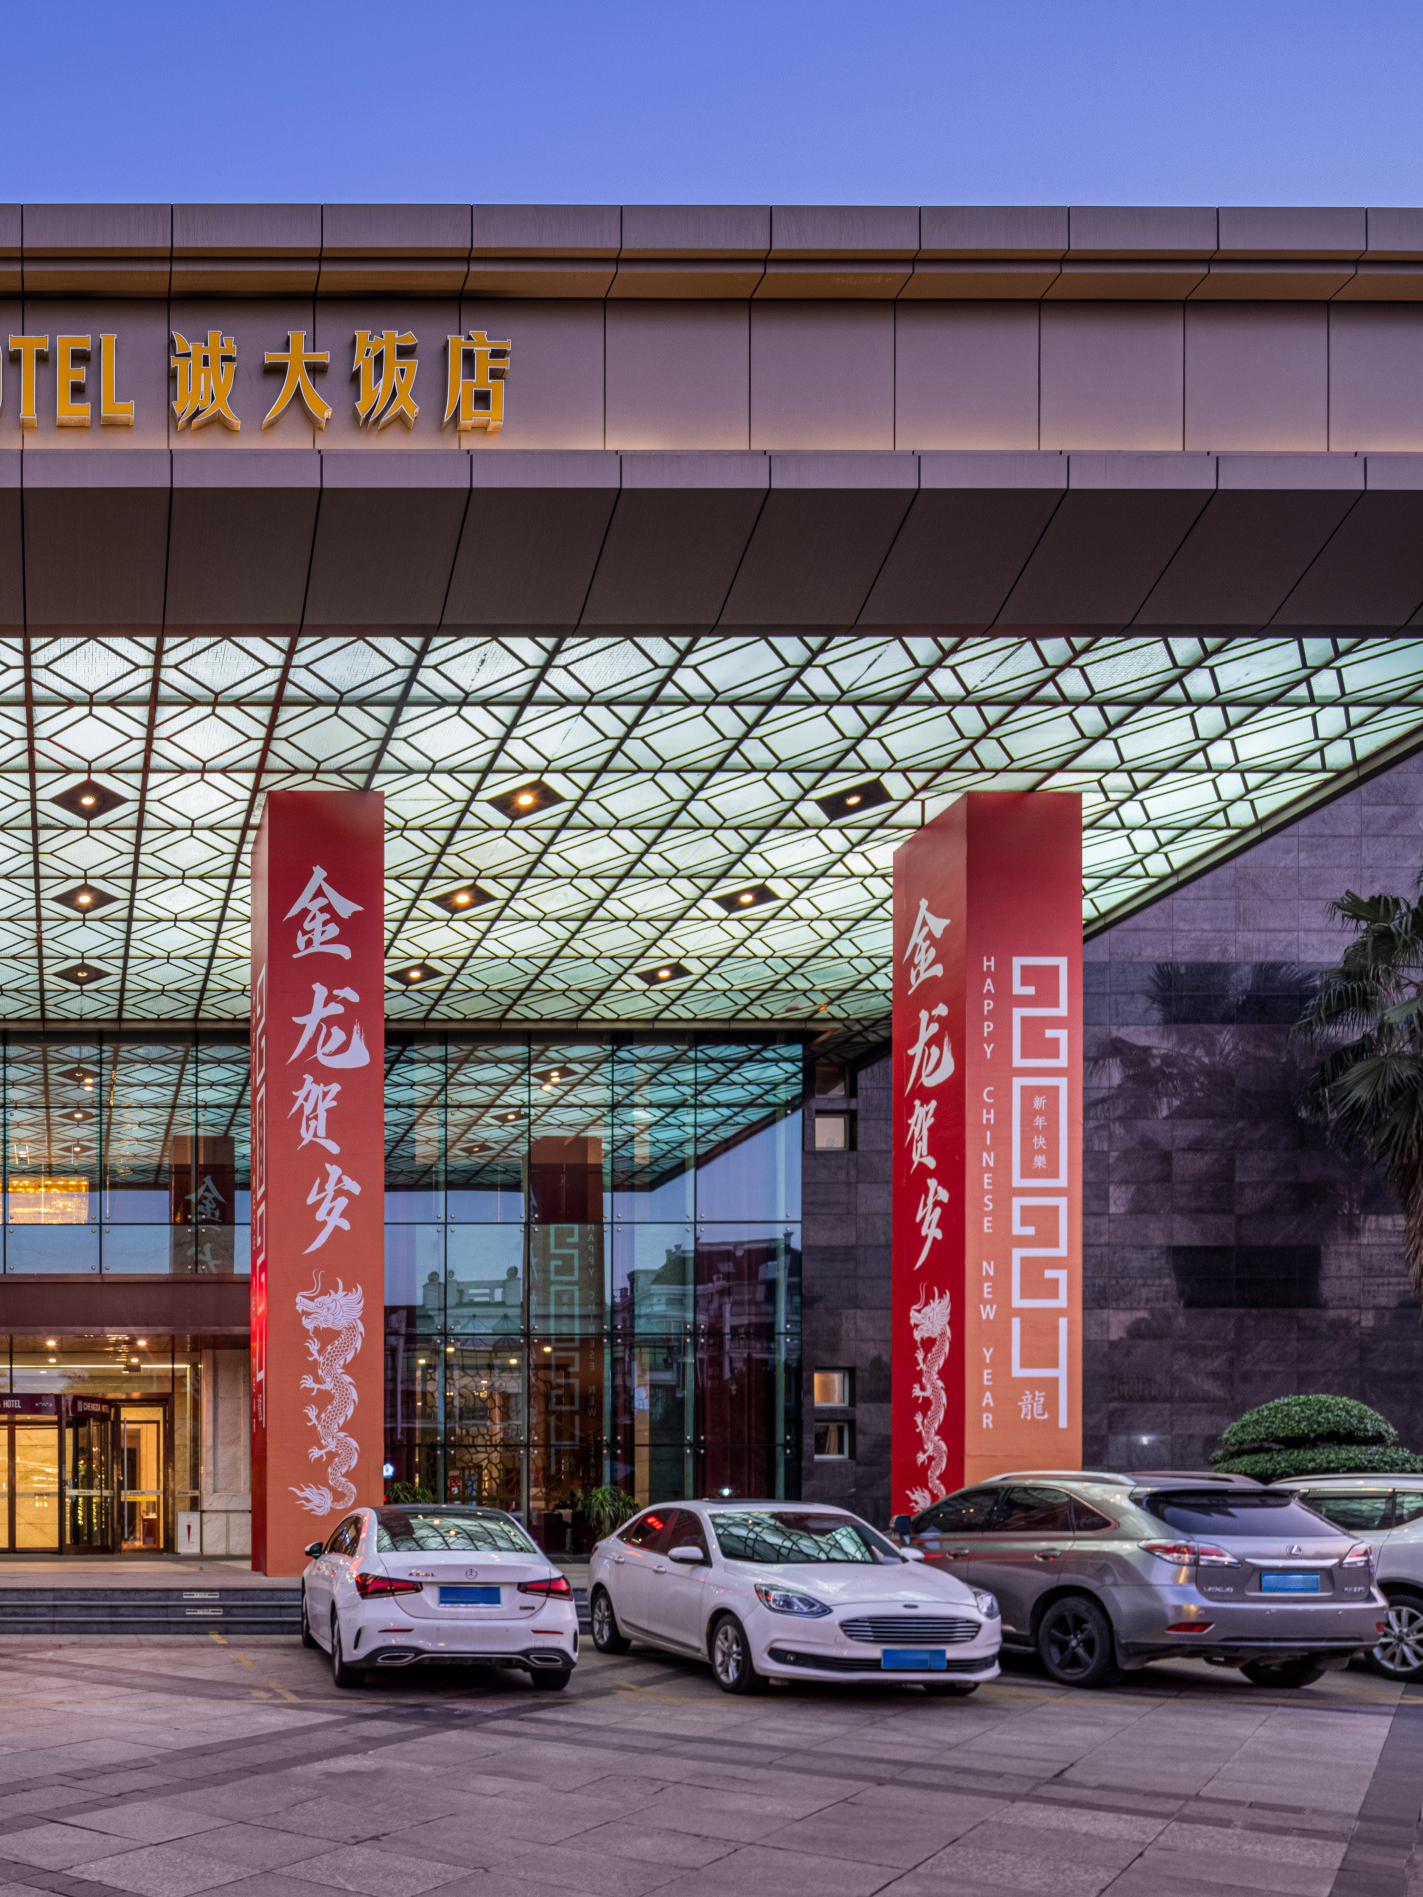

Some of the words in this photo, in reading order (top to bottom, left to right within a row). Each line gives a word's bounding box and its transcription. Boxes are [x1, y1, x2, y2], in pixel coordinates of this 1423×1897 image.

[170, 329, 512, 432] 诚大饭店
[982, 956, 996, 1060] HAPPY
[282, 865, 372, 1255] 金龙贺岁
[902, 897, 956, 1271] 金龙贺岁
[982, 1086, 995, 1234] CHINESE
[1032, 1094, 1048, 1171] 新年快樂
[979, 1260, 998, 1321] NEW
[3, 1399, 22, 1409] HOTEL
[981, 1347, 995, 1430] YEAR
[1017, 1389, 1050, 1421] 龍
